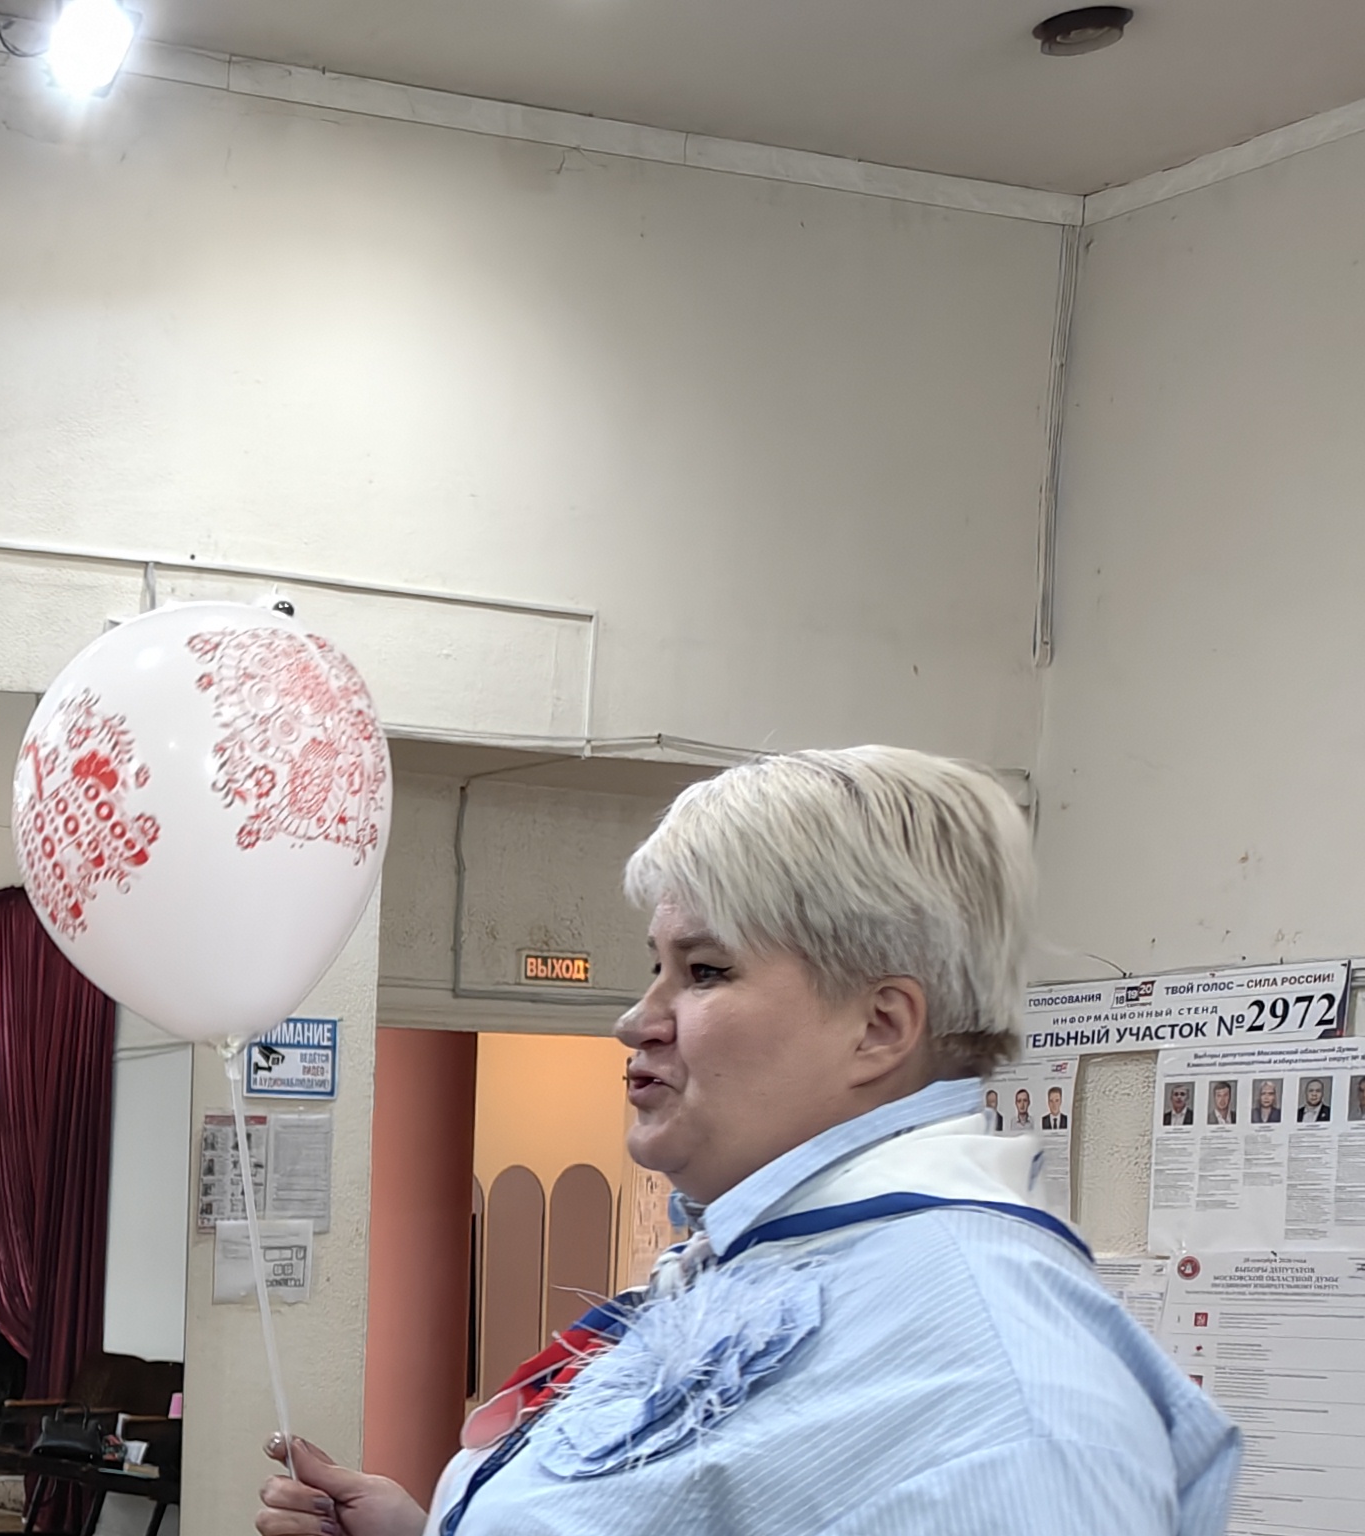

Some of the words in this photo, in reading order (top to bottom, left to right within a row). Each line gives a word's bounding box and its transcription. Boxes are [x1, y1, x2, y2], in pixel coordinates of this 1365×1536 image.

[526, 957, 586, 980] ВЫХОД
[1115, 995, 1125, 1006] 18
[1127, 989, 1138, 1000] 19
[1139, 983, 1153, 995] 20
[1164, 982, 1194, 996] ТВОЙ
[1196, 981, 1234, 993] ГОЛОС
[1247, 979, 1278, 989] СИЛА
[1281, 972, 1335, 986] РОССИИ!
[1029, 993, 1102, 1007] ГОЛОСОВАНИЯ
[1052, 1008, 1173, 1026] ИНФОРМАЦИОННЫЙ
[1178, 1005, 1219, 1016] СТЕНД
[257, 1022, 332, 1045] НИМАНИЕ
[1116, 1022, 1208, 1043] УЧАСТОК
